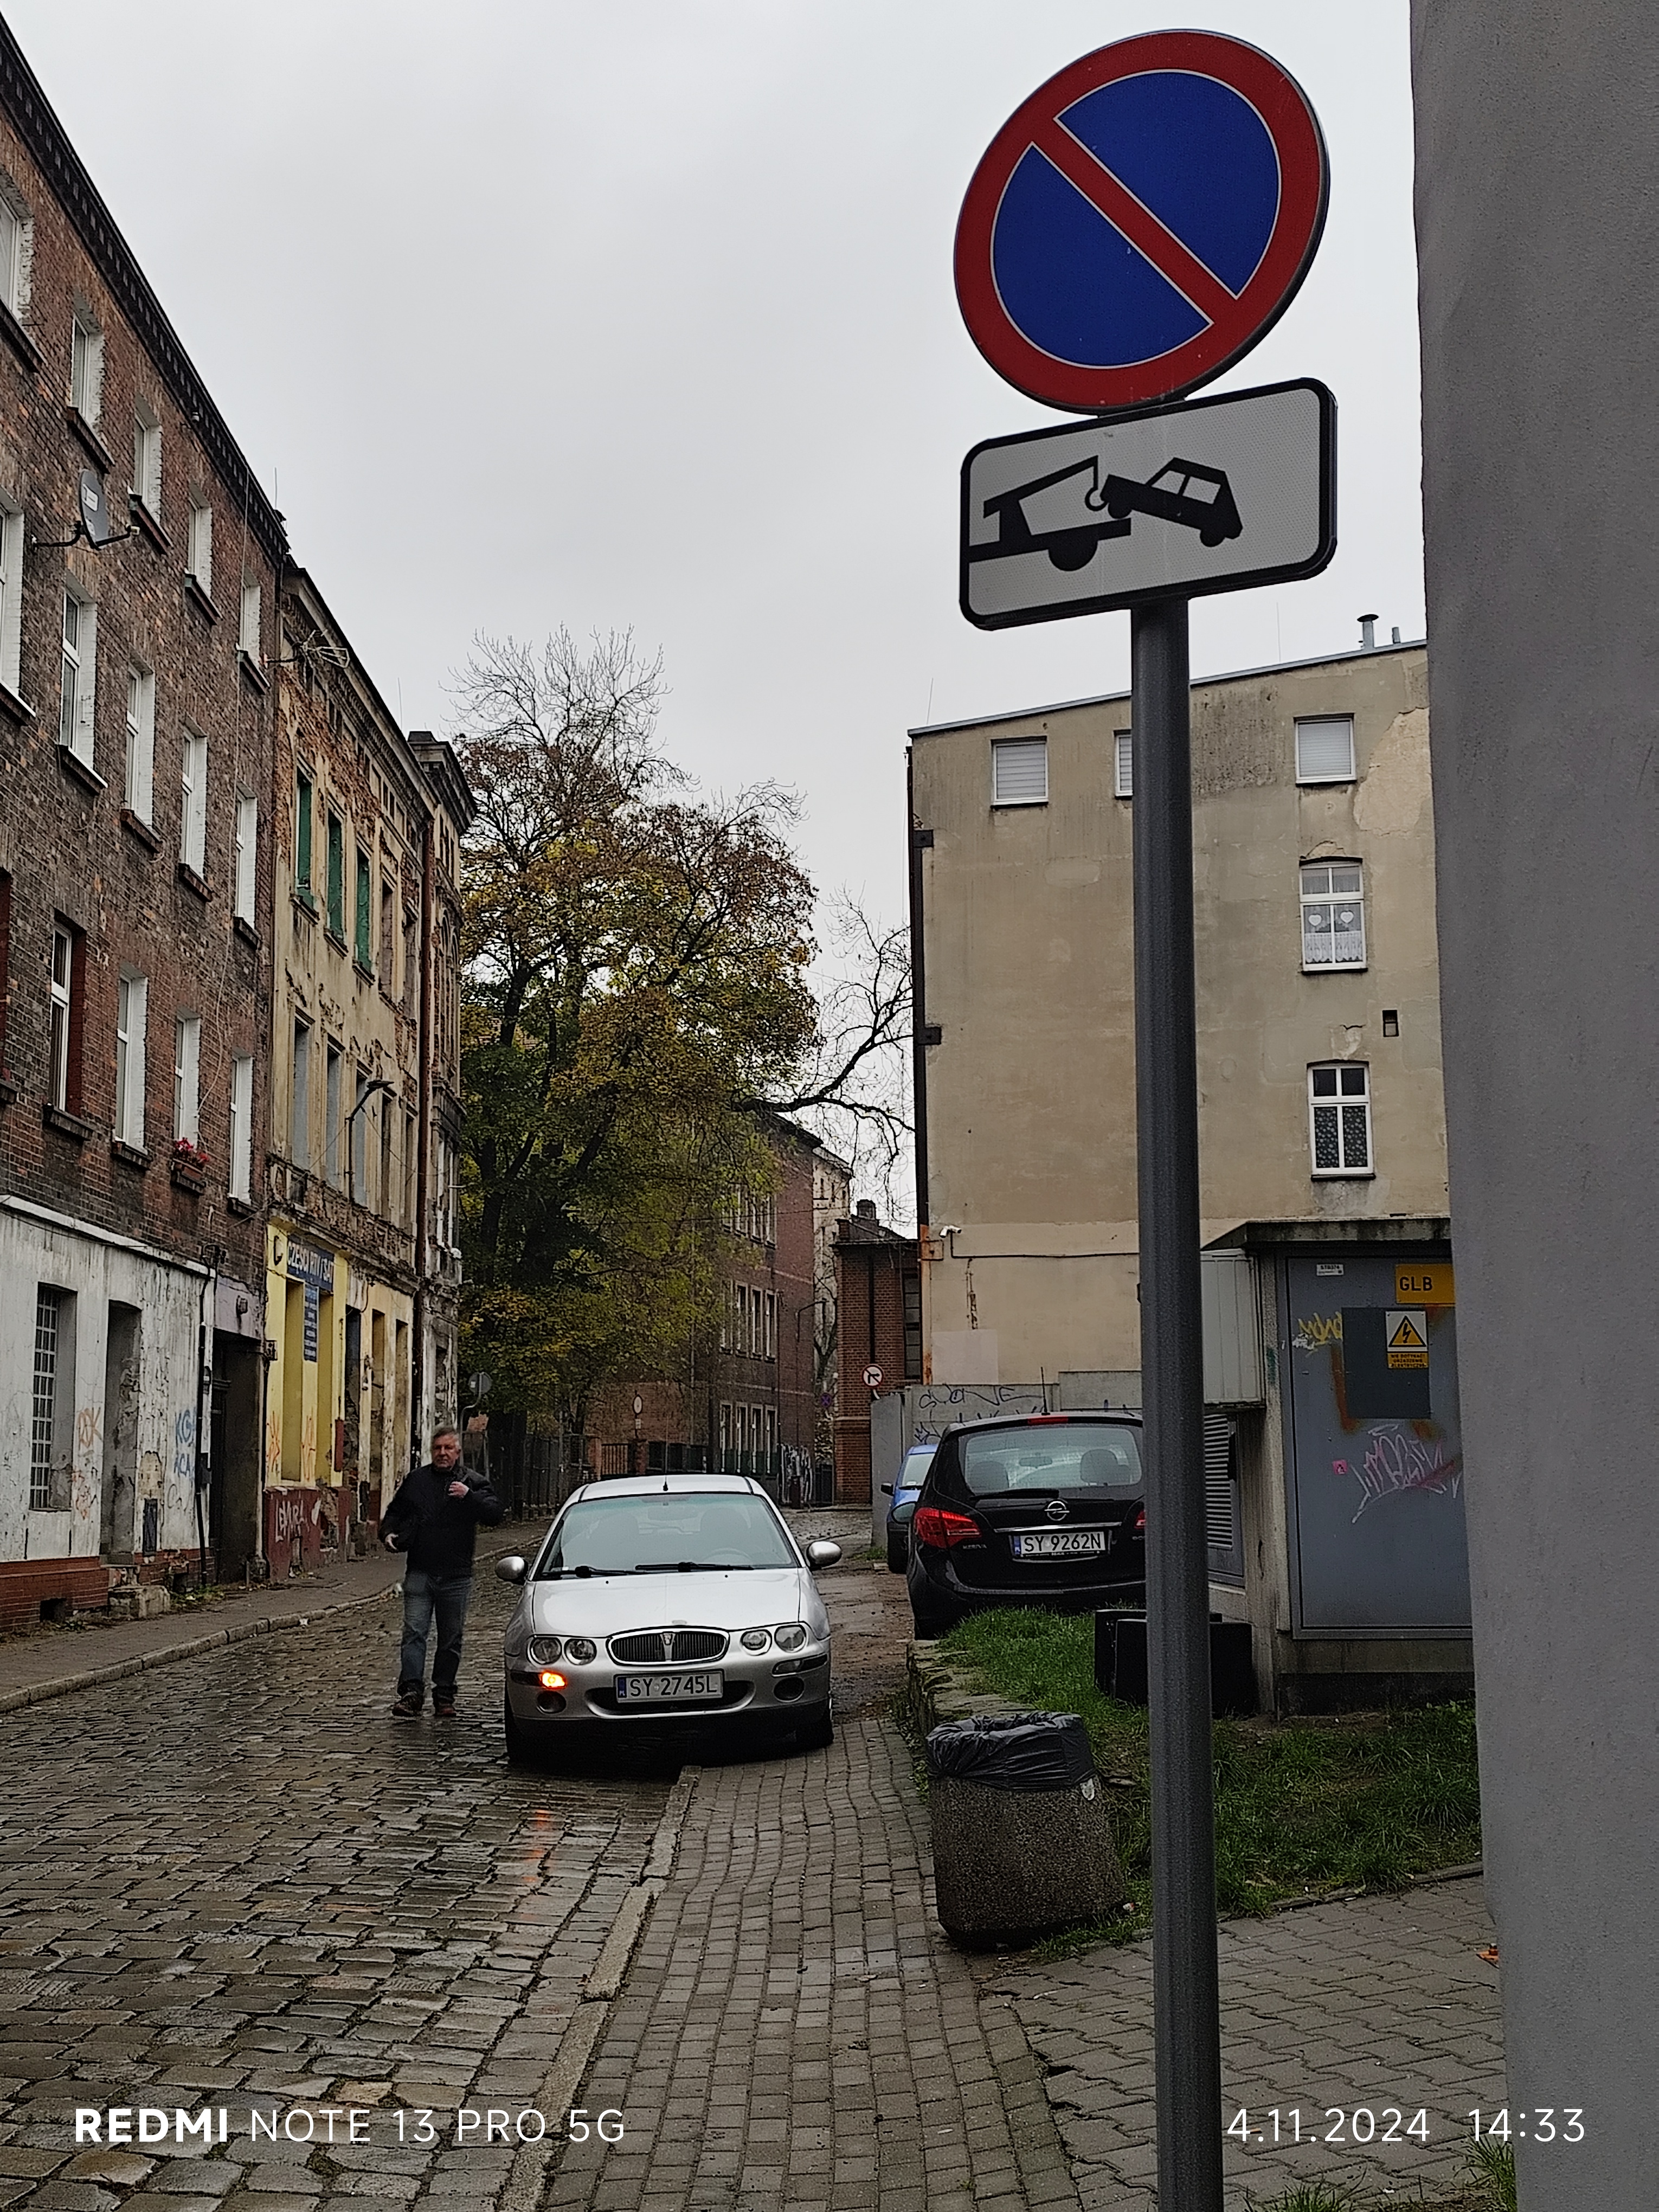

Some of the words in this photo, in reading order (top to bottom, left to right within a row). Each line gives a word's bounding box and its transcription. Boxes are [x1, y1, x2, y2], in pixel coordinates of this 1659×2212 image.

[1399, 1276, 1433, 1291] GLB
[1024, 1536, 1044, 1552] SY
[1050, 1533, 1101, 1551] 9262N
[629, 1678, 653, 1697] SY
[660, 1675, 717, 1696] 2745L
